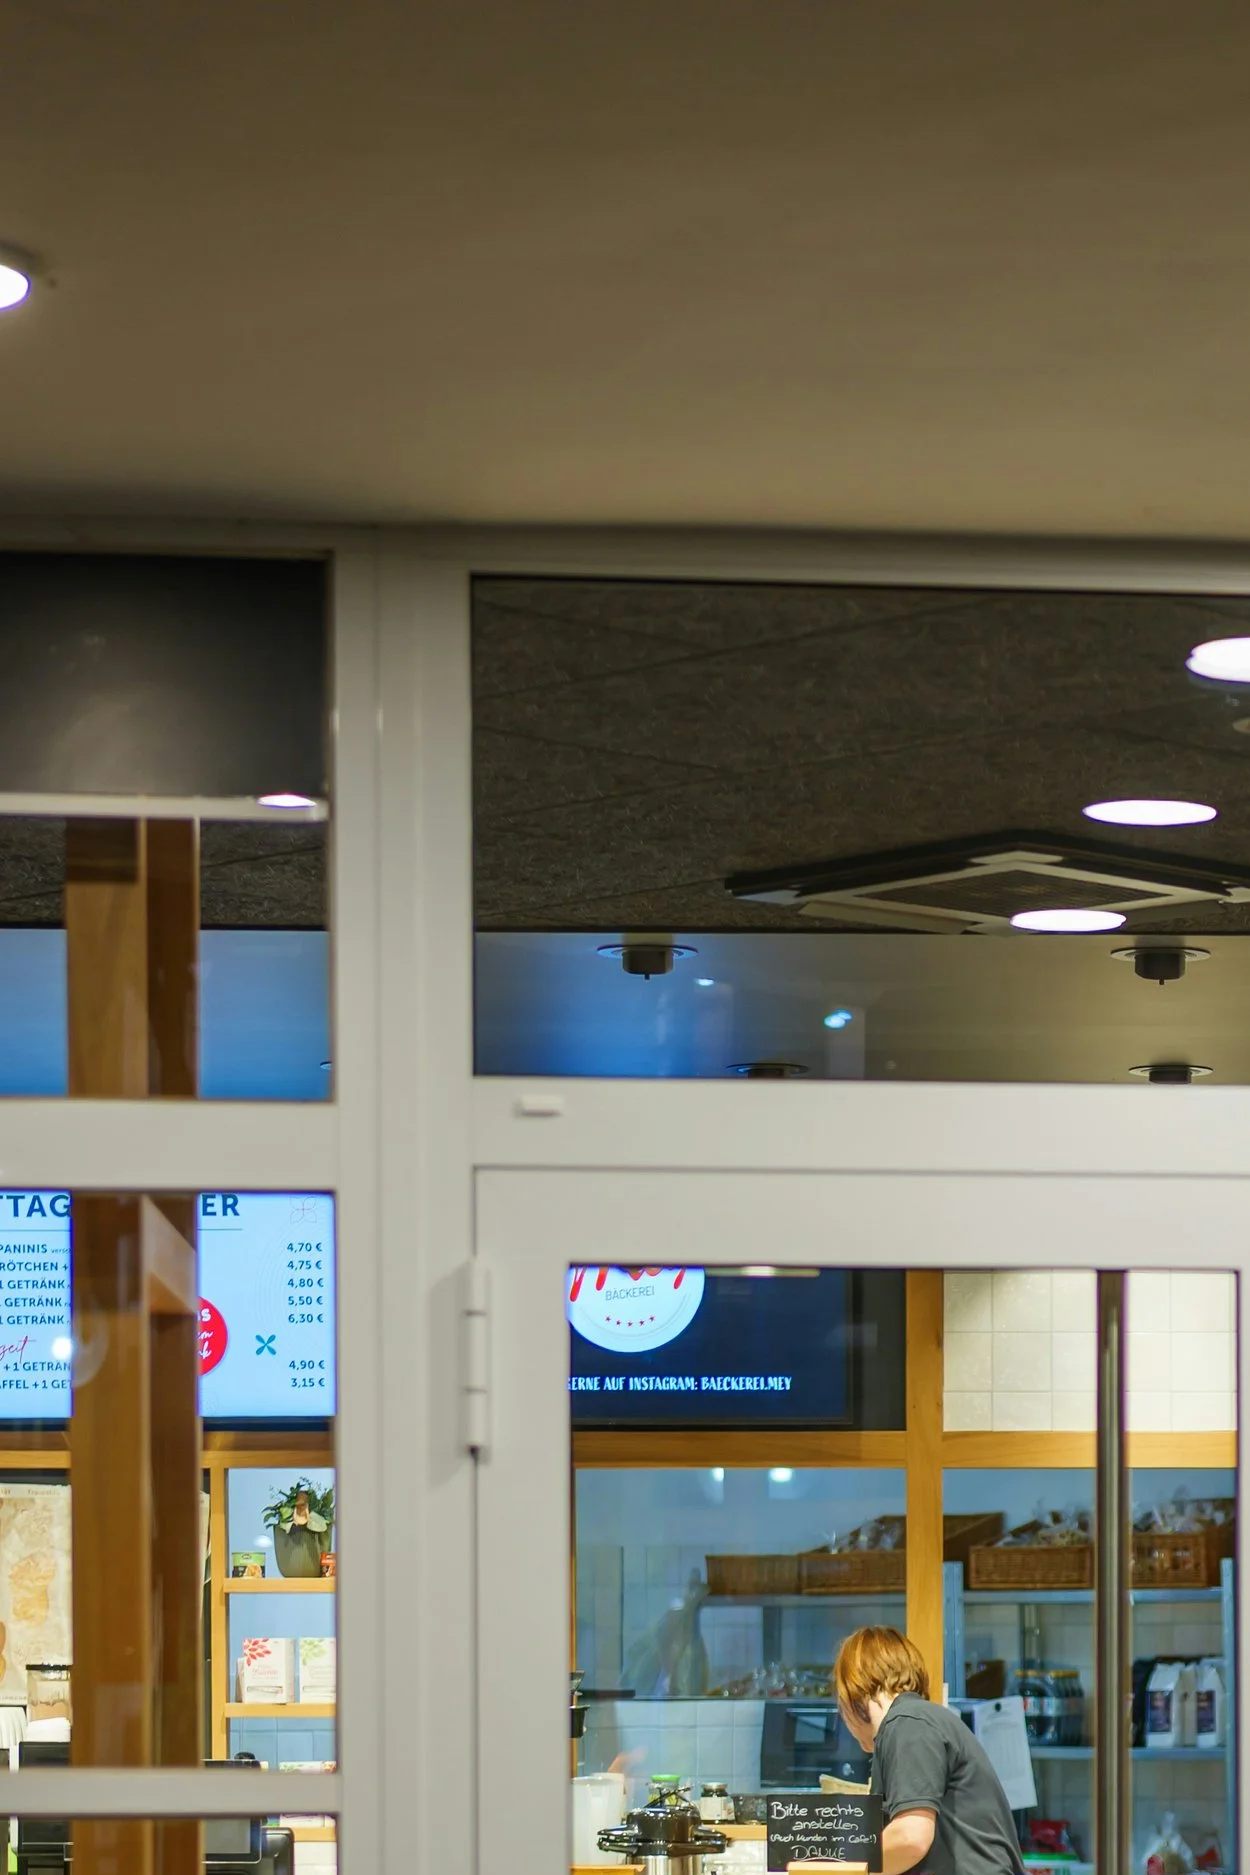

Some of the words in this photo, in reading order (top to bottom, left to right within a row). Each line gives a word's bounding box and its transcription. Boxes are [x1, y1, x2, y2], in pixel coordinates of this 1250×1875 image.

[0, 1194, 71, 1218] TAG
[287, 1242, 312, 1253] 4,70
[315, 1242, 322, 1252] €
[287, 1260, 312, 1271] 4,75
[315, 1260, 322, 1270] €
[8, 1277, 65, 1289] GETRÄNK
[287, 1278, 314, 1288] 4,80
[317, 1278, 324, 1287] €
[605, 1284, 655, 1301] BÄCKEREI
[5, 1295, 62, 1307] GETRÄNK
[288, 1296, 312, 1306] 5,50
[316, 1296, 324, 1305] €
[7, 1313, 64, 1325] GETRÄNK
[288, 1313, 313, 1324] 6,30
[317, 1313, 324, 1323] €
[289, 1360, 315, 1370] 4,90
[318, 1360, 325, 1369] €
[0, 1380, 29, 1389] FFEL
[291, 1378, 315, 1388] 3,15
[318, 1378, 325, 1387] €
[603, 1376, 625, 1391] AUF
[629, 1376, 698, 1391] INSTAGRAM:
[701, 1376, 792, 1391] BAECKEREI.MEY
[771, 1801, 808, 1820] Bitte
[815, 1803, 864, 1818] rechts
[792, 1818, 859, 1831] anstellen
[770, 1833, 794, 1843] (Auch
[796, 1833, 828, 1842] Kunden
[791, 1845, 847, 1861] DANKE
